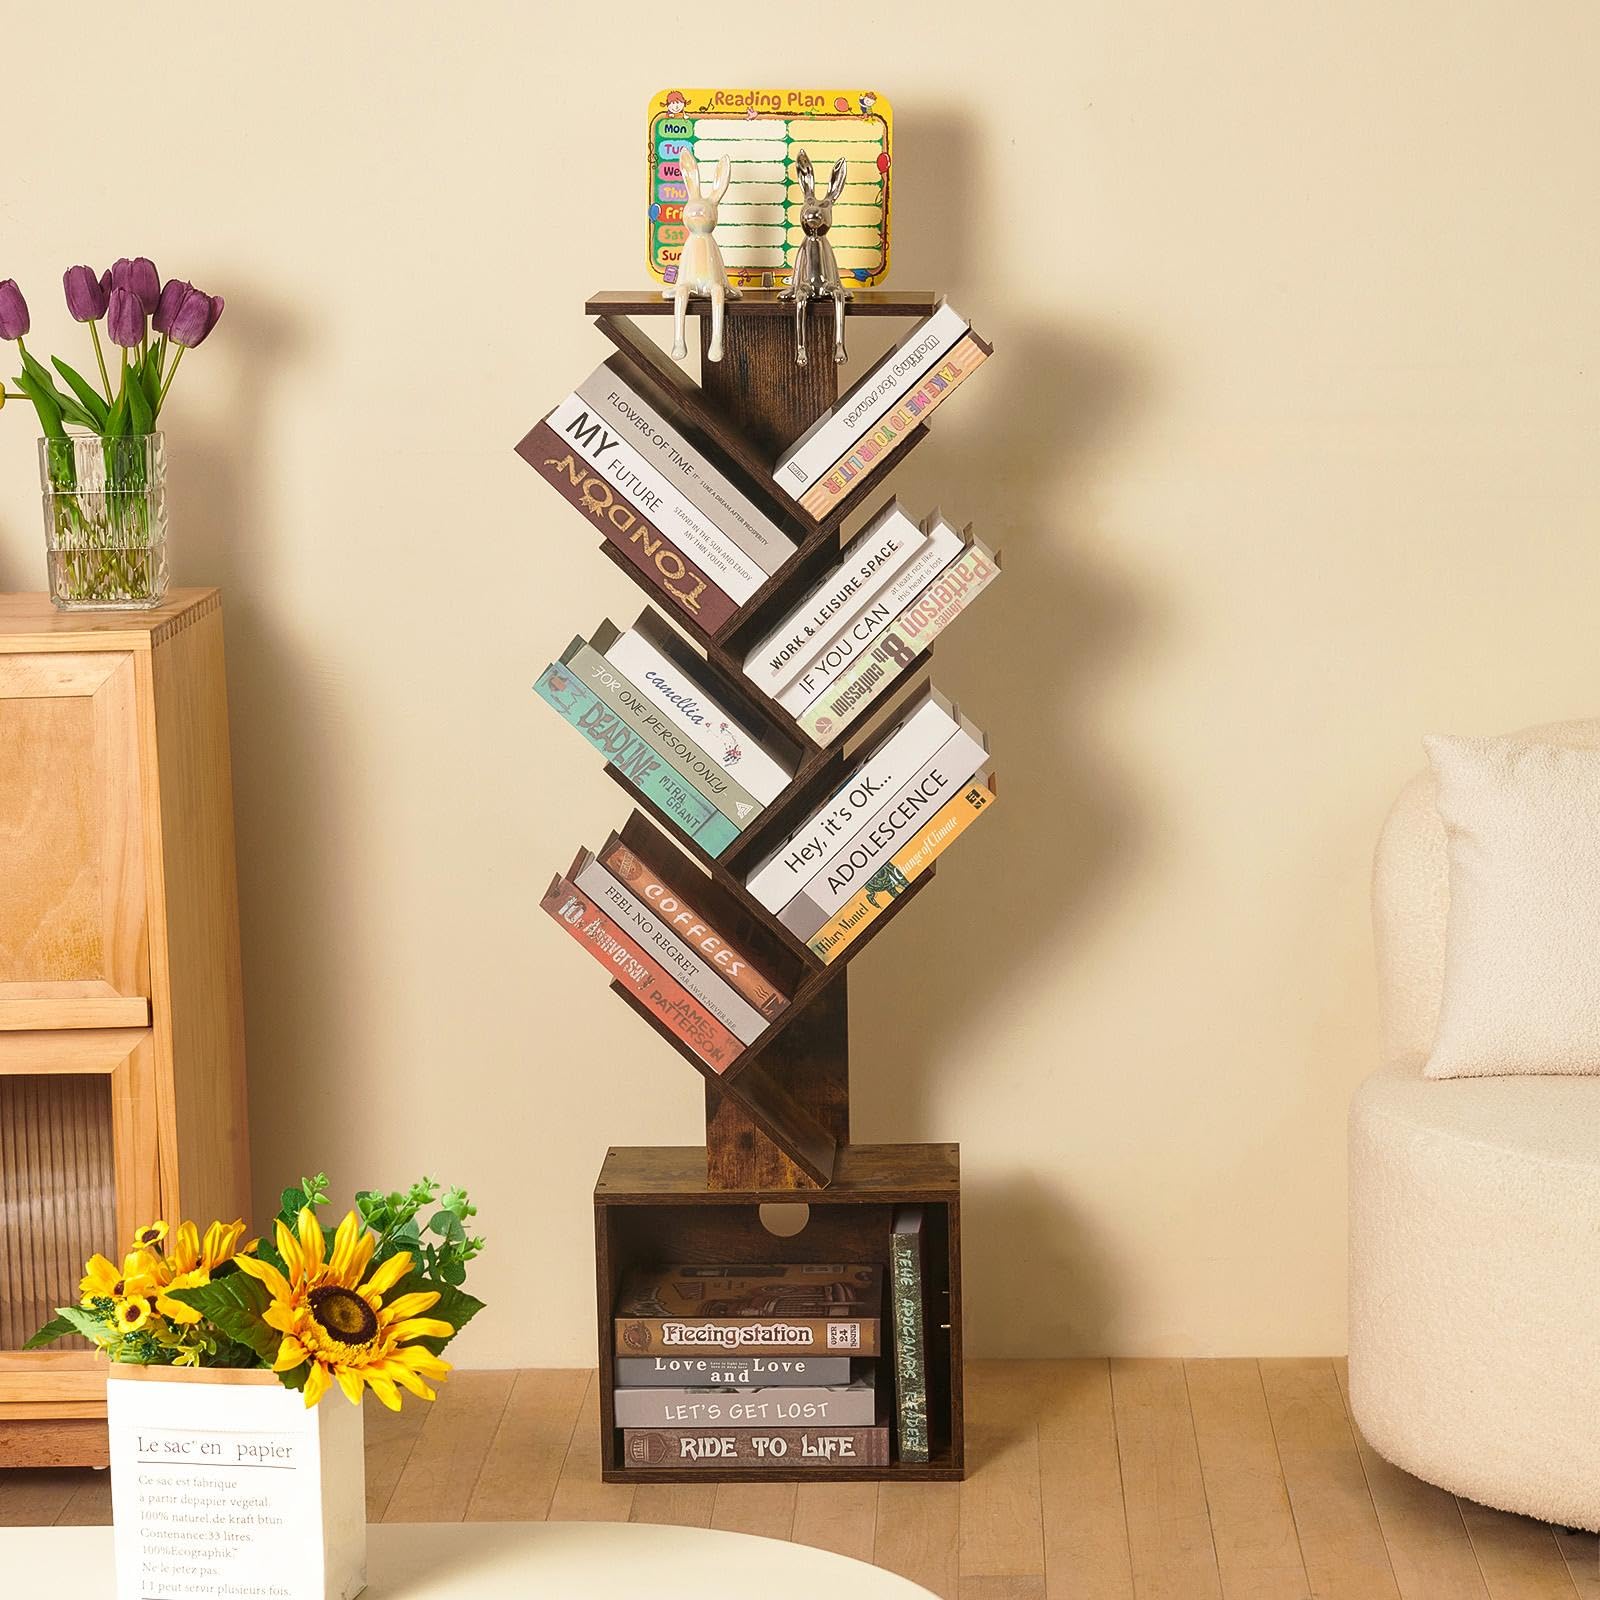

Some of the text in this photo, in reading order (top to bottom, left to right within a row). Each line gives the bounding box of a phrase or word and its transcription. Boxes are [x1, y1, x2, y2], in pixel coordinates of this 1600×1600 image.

[715, 91, 825, 109] Reading Plan
[664, 124, 687, 134] Mon
[663, 166, 683, 177] We
[663, 187, 687, 198] Thu
[664, 229, 683, 240] Sat
[841, 333, 941, 429] Waiting for sunset
[922, 359, 962, 399] TAKE
[887, 406, 913, 433] TO
[903, 389, 932, 417] ME
[606, 391, 654, 438] FLOWERS
[650, 432, 670, 452] OF
[665, 447, 695, 476] TIME
[729, 508, 745, 524] AFTER
[855, 423, 897, 464] YOUR
[564, 411, 663, 513] MY FUTURE
[821, 454, 864, 497] LITER
[543, 453, 708, 616] LONDON
[672, 506, 753, 583] STAND IN THE SUN AND ENJOY
[683, 529, 695, 541] MY
[692, 538, 708, 554] THIN
[889, 549, 935, 595] at least not like
[896, 555, 943, 603] this heart is lost
[768, 538, 899, 671] WORK & LEISURE SPACE
[899, 551, 992, 639] Patterson
[934, 599, 963, 630] James
[798, 602, 890, 694] IF YOU CAN
[644, 670, 704, 726] camellia
[828, 661, 886, 718] confession
[576, 700, 661, 787] DEADLINE
[617, 689, 646, 717] ONE
[641, 712, 697, 765] PERSON
[658, 774, 688, 804] MIRA
[664, 796, 700, 830] GRANT
[784, 776, 893, 874] Hey, it's OK...
[823, 767, 948, 895] ADOLESCENCE
[923, 812, 959, 848] Climate
[890, 846, 925, 882] Change
[917, 838, 934, 855] of
[603, 885, 699, 978] FEEL NO REGRET
[643, 883, 746, 978] COFFEES
[816, 902, 870, 958] Hilary Mantel
[582, 917, 656, 991] Anniversary
[676, 971, 690, 985] FAR
[648, 988, 726, 1063] PATTERSON
[672, 995, 717, 1039] JAMES
[741, 1324, 812, 1344] station
[840, 1329, 848, 1342] 24
[655, 1357, 707, 1371] Love
[711, 1370, 750, 1383] and
[753, 1358, 806, 1373] Love
[664, 1402, 829, 1420] LET'S GET LOST
[904, 1391, 921, 1446] READER
[138, 1436, 159, 1453] Le
[200, 1442, 221, 1455] en
[237, 1441, 293, 1462] papier
[680, 1434, 856, 1461] RIDE TO LIFE
[138, 1475, 153, 1486] Ce
[156, 1478, 173, 1487] sac
[176, 1478, 190, 1487] est
[141, 1511, 169, 1521] 100%
[229, 1514, 255, 1525] kraft
[142, 1562, 158, 1573] Ne
[158, 1582, 182, 1594] peut
[184, 1585, 214, 1594] servir
[217, 1583, 267, 1600] plusieurs
